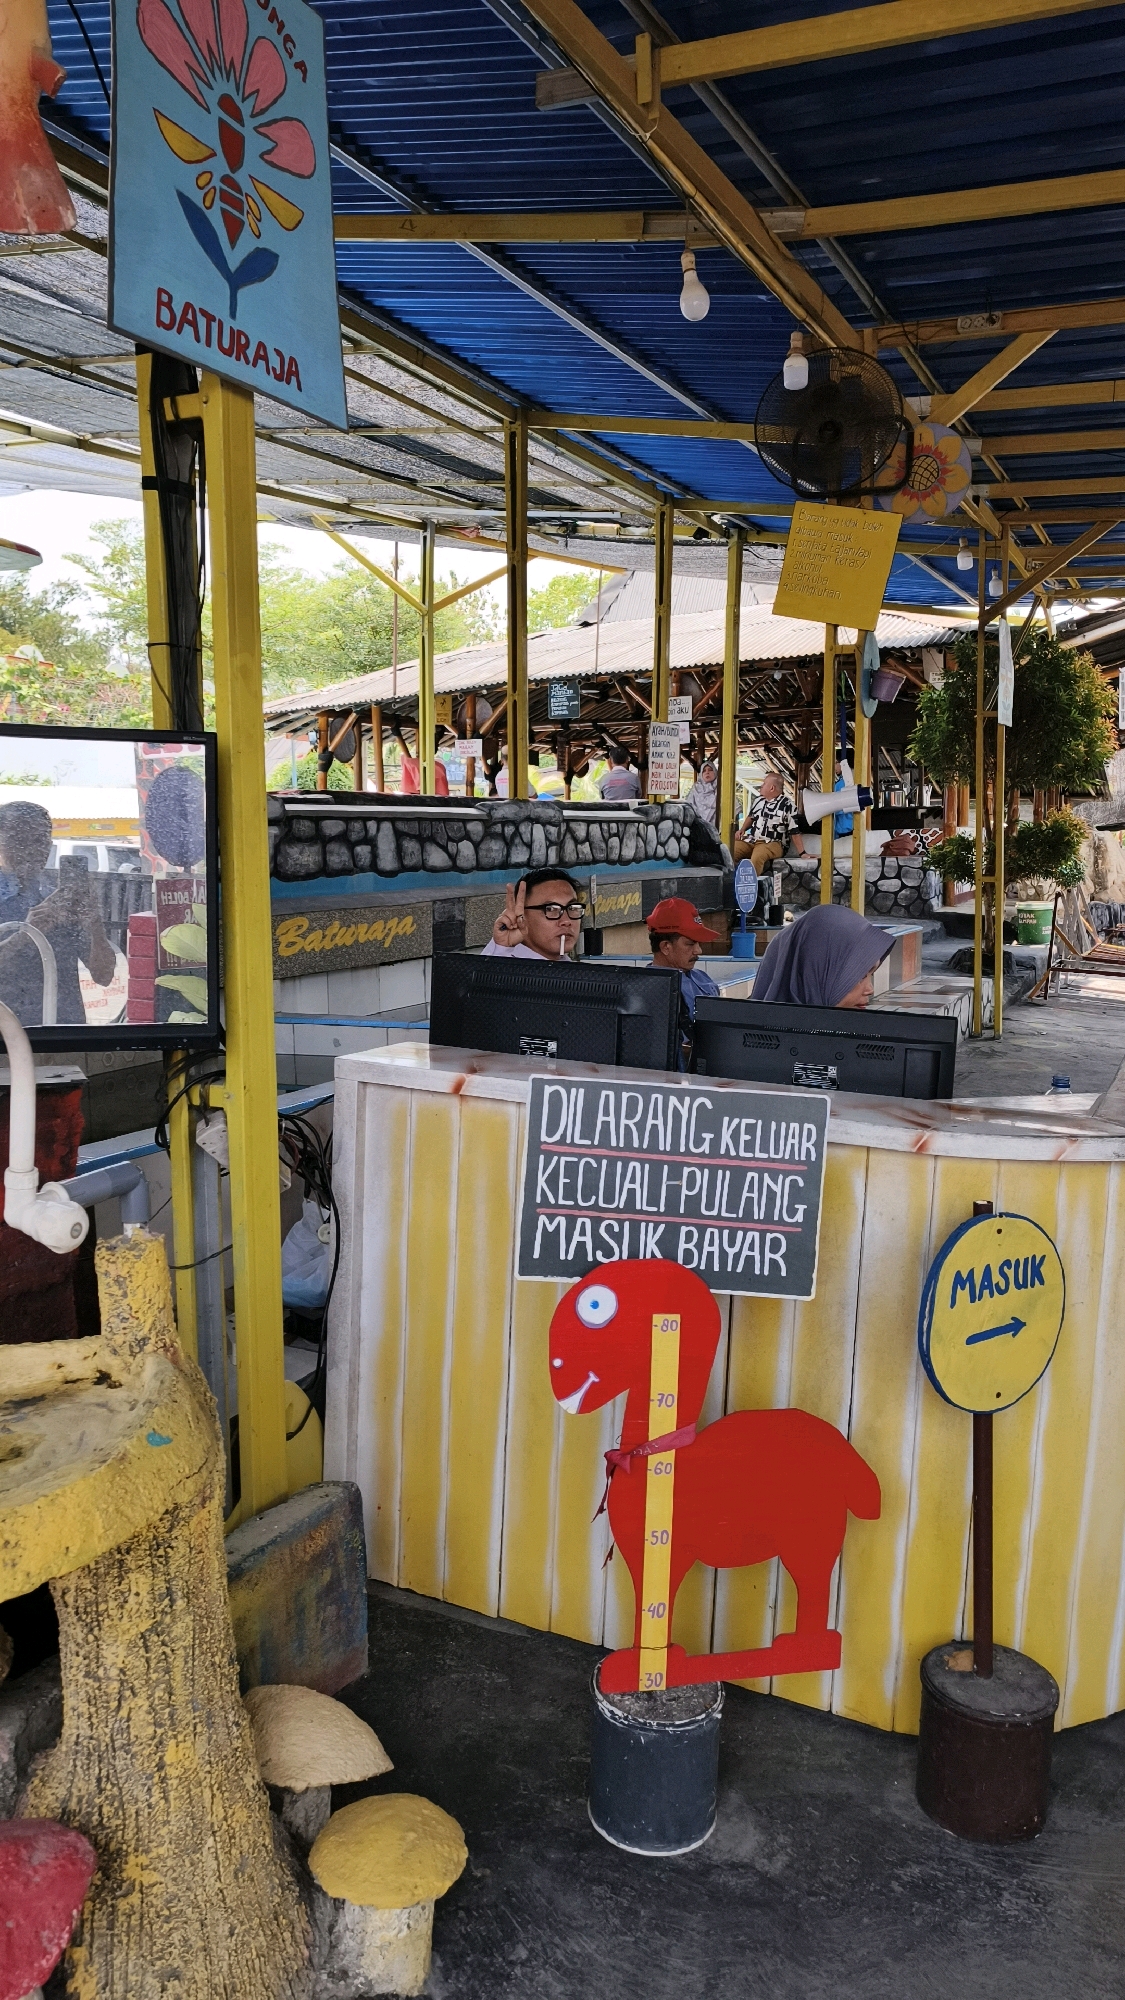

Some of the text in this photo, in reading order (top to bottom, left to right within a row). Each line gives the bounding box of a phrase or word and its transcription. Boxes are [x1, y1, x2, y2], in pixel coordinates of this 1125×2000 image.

[256, 0, 308, 83] UNGA
[155, 286, 302, 392] BATURAJA
[276, 915, 416, 957] Baturaja
[540, 1084, 816, 1161] DILARANG KELUAR
[536, 1154, 807, 1222] KECUALI PULANG
[533, 1214, 787, 1276] MASUK BAYAR
[950, 1253, 1046, 1309] MASUK
